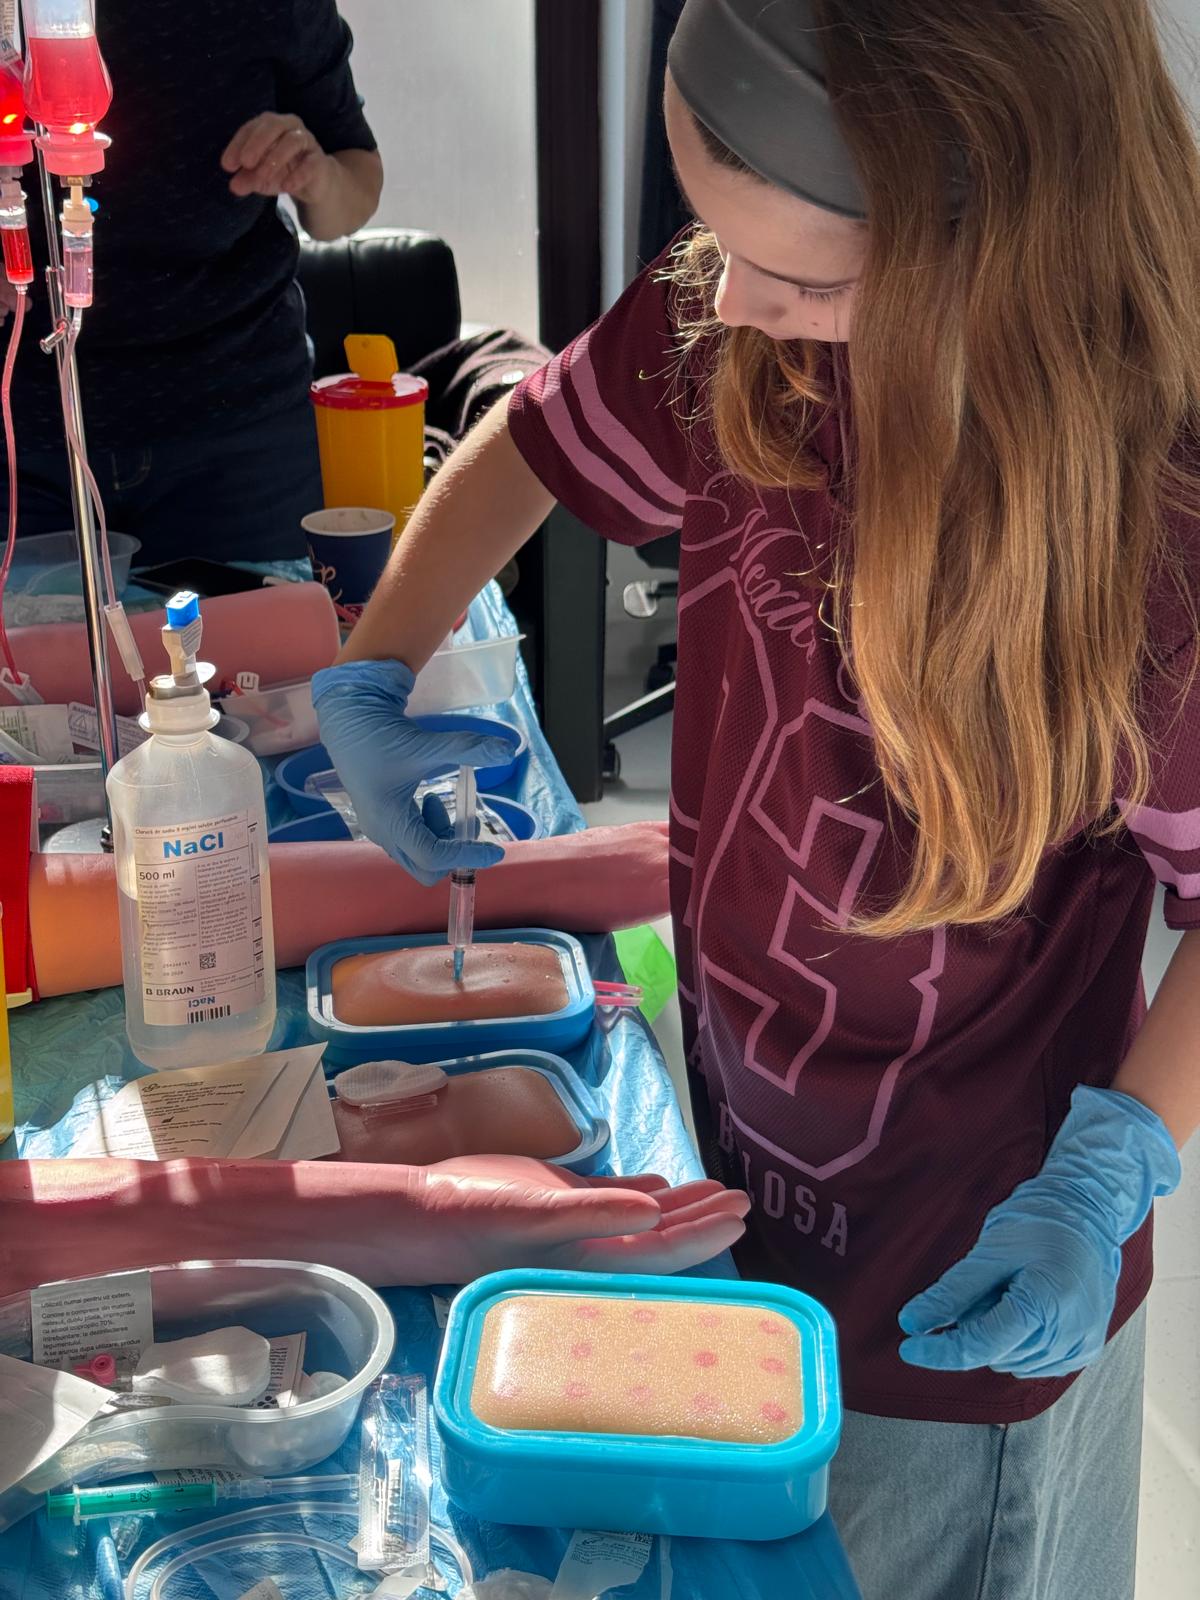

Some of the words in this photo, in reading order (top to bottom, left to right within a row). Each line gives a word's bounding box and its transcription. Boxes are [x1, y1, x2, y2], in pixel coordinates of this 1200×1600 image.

[163, 832, 224, 859] NaCl
[139, 871, 160, 881] 500
[162, 869, 176, 880] ml
[156, 986, 195, 996] BRAUN
[188, 996, 216, 1009] NaCl
